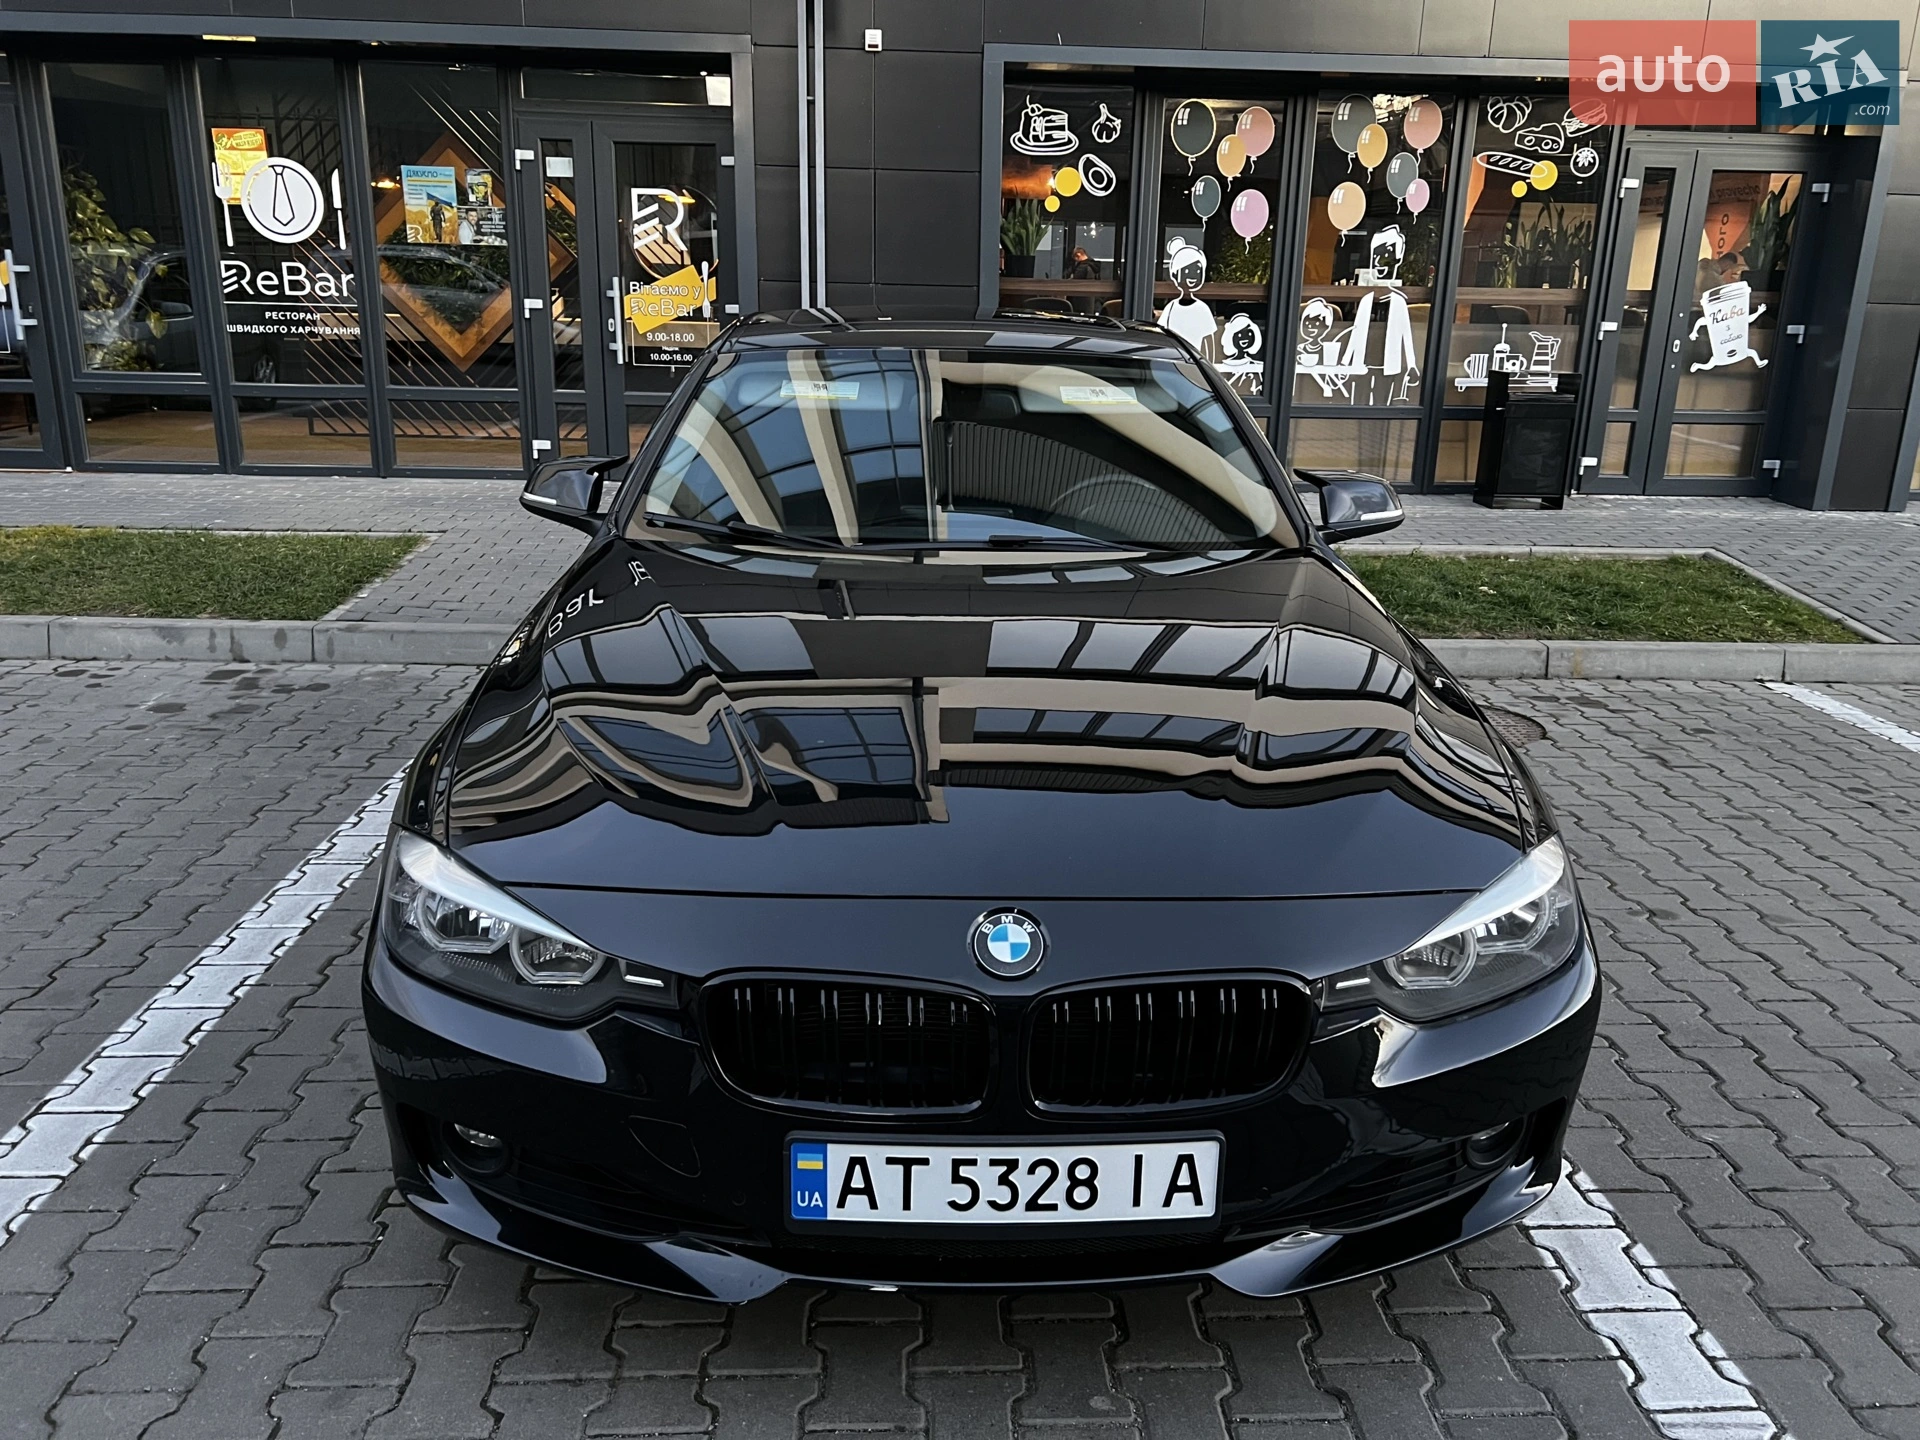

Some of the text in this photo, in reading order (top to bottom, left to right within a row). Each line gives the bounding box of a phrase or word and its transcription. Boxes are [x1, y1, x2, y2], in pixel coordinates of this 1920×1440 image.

[219, 260, 355, 297] ReBar
[629, 281, 702, 299] Вітаємо у
[264, 311, 320, 321] РЕСТОРАН
[630, 297, 698, 317] ReBar
[1709, 304, 1745, 325] Кава
[226, 324, 361, 335] ШВИДКОГО ХАРЧУВАННЯ
[645, 332, 695, 342] 9.00-18.00
[649, 353, 693, 361] 10.00-16.00
[981, 915, 1036, 934] BMW
[835, 1152, 1205, 1212] AT 5328 IA
[797, 1190, 824, 1207] UA
